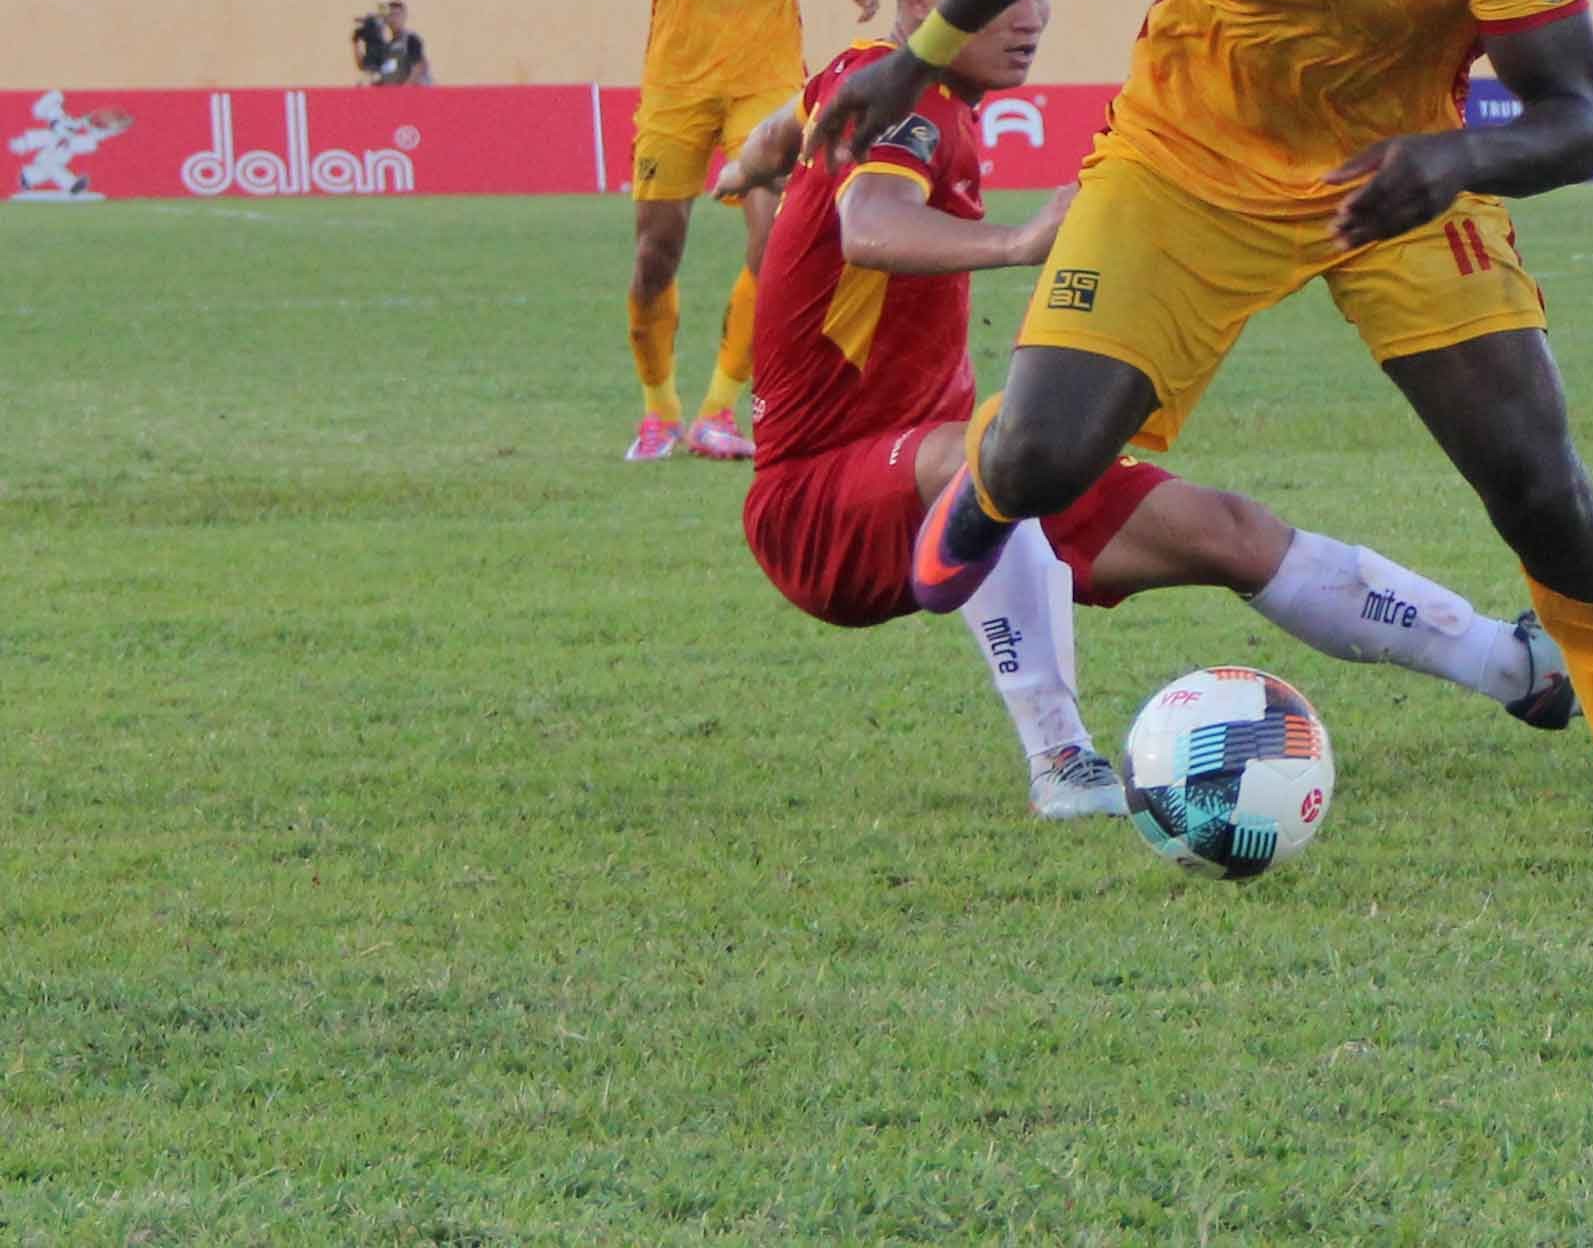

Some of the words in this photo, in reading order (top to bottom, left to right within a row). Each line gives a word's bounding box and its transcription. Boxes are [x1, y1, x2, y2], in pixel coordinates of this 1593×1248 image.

[180, 93, 415, 195] dalan
[1360, 588, 1418, 628] mitre
[981, 617, 1022, 674] mitre
